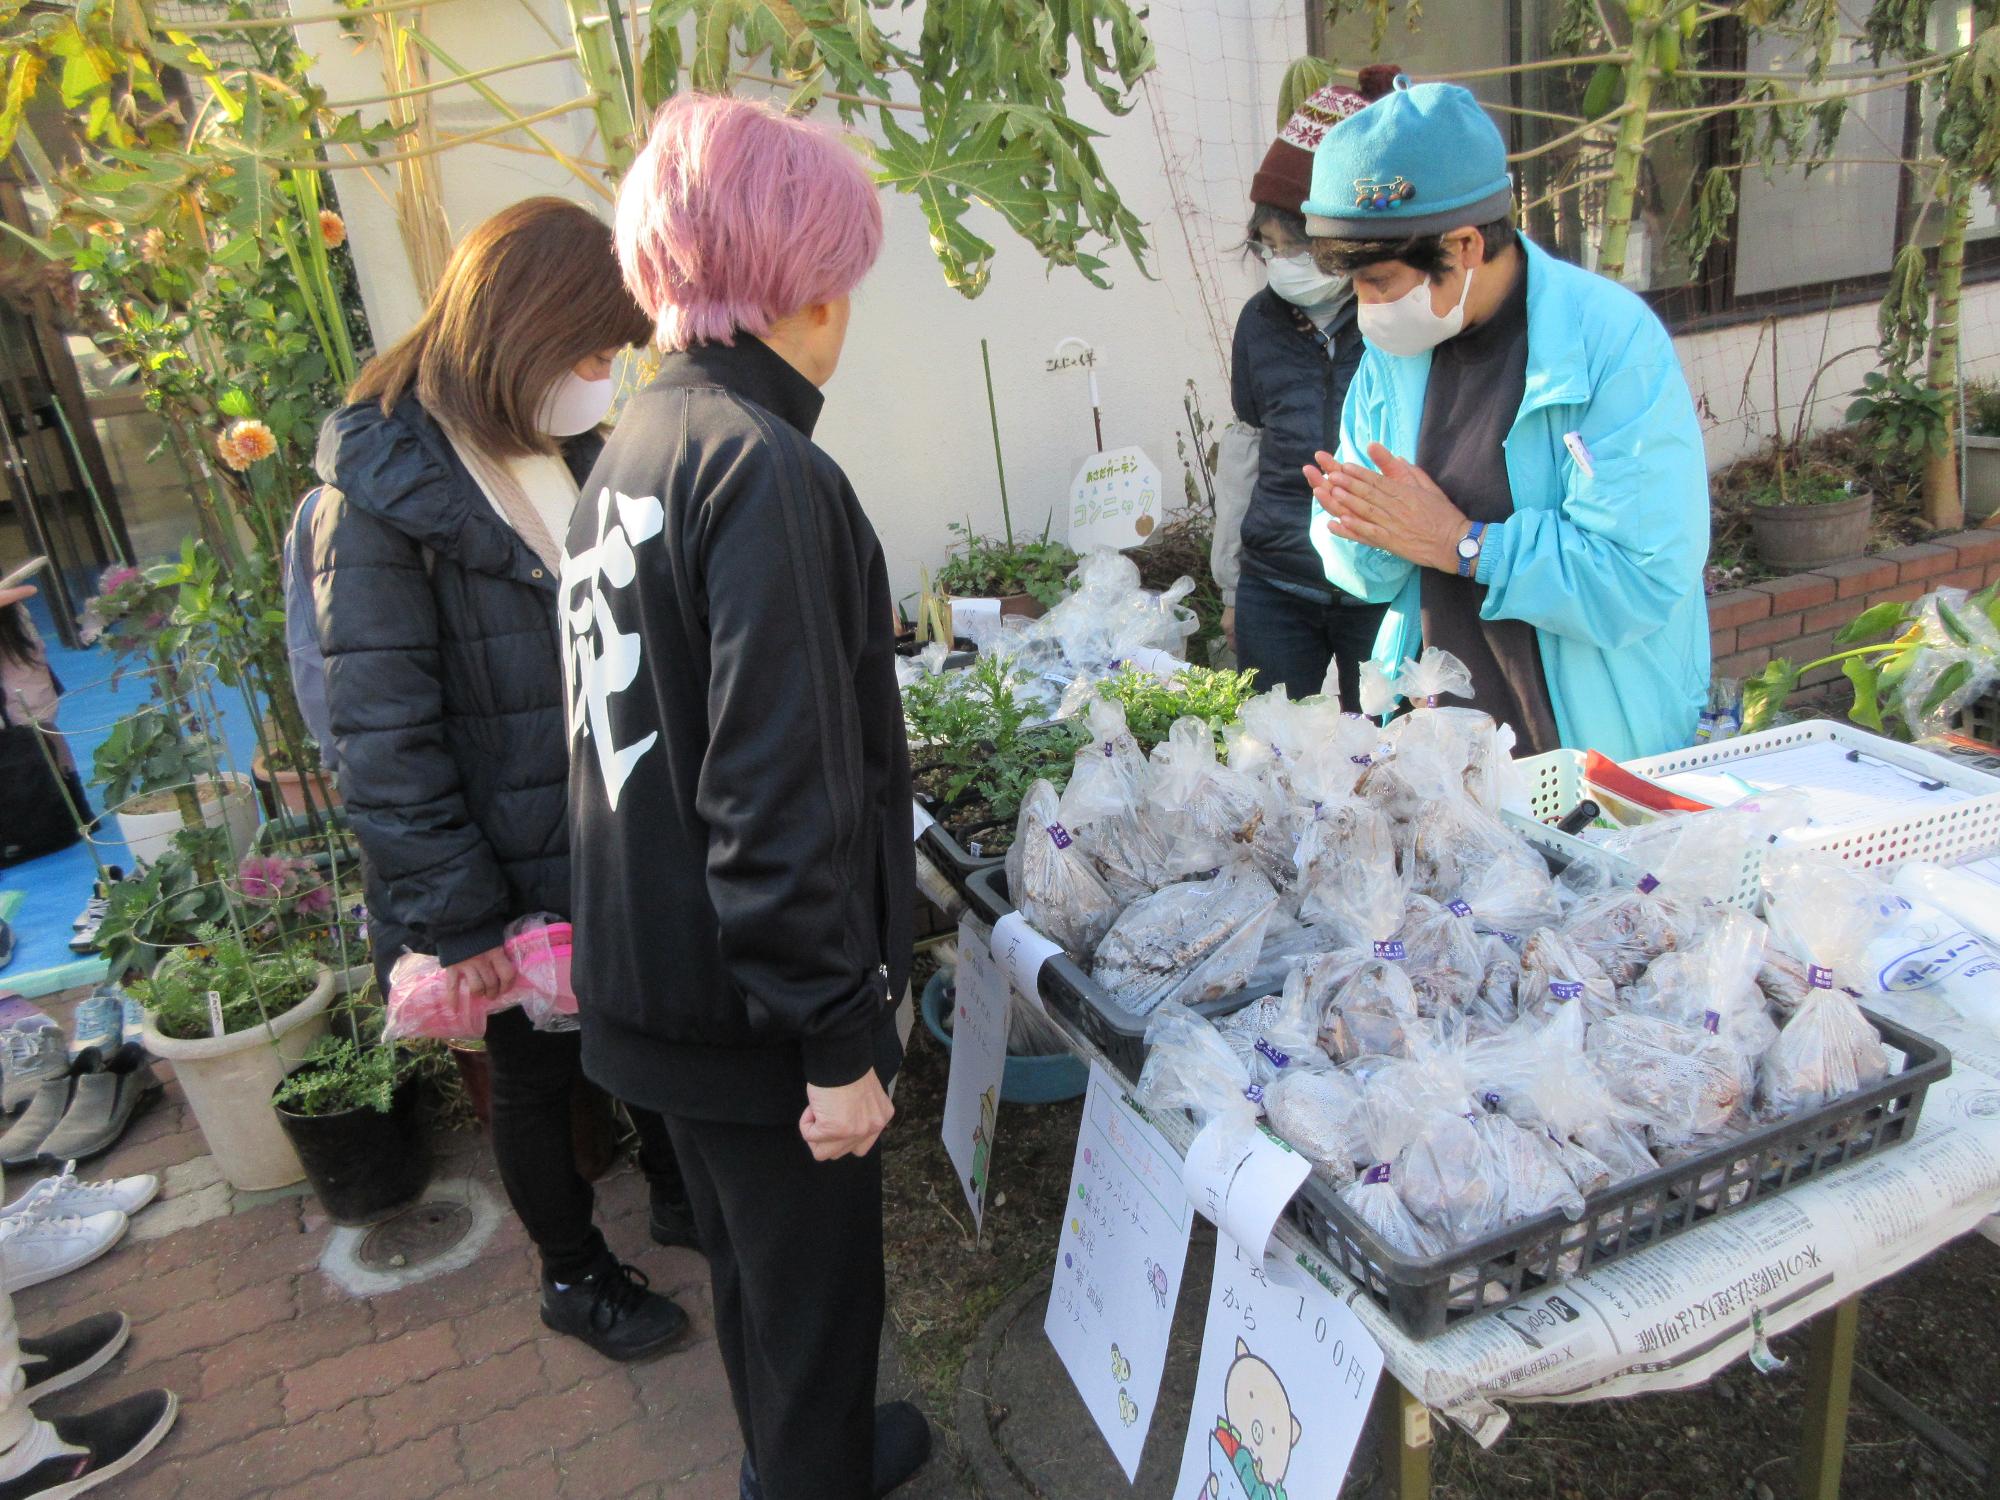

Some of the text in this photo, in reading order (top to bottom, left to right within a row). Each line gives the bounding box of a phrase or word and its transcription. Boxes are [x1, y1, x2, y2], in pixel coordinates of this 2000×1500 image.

[1073, 489, 1155, 527] コンニャク
[1222, 1285, 1256, 1331] から
[1635, 1244, 1822, 1354] 米の国際法違反は明確
[1297, 1295, 1365, 1400] 100円
